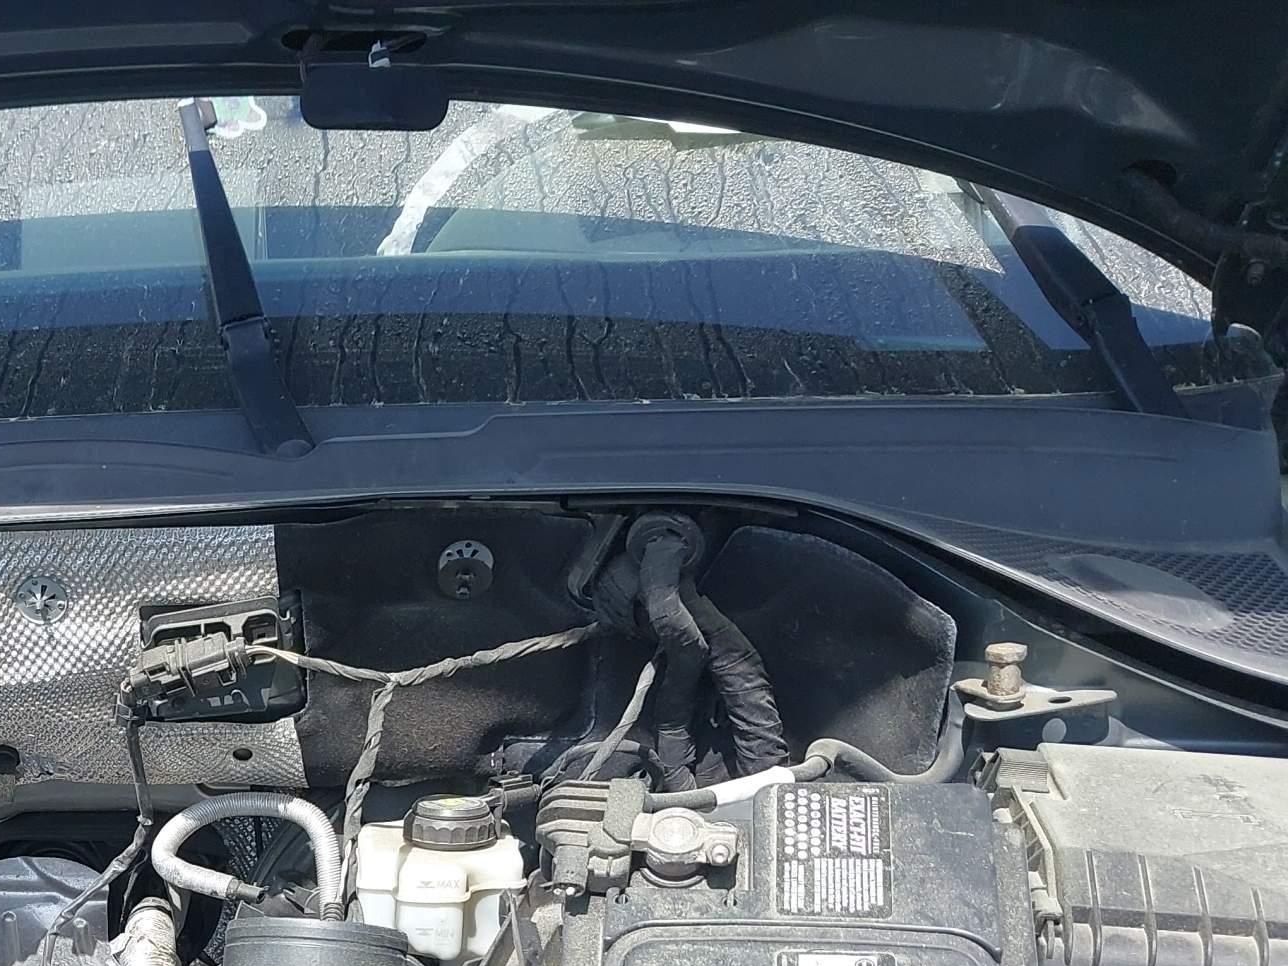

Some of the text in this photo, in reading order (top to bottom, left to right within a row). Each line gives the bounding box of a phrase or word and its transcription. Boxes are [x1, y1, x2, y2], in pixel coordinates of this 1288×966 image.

[830, 797, 848, 851] BATTERY
[848, 796, 867, 855] EXACT-FIT
[436, 880, 460, 888] MAX
